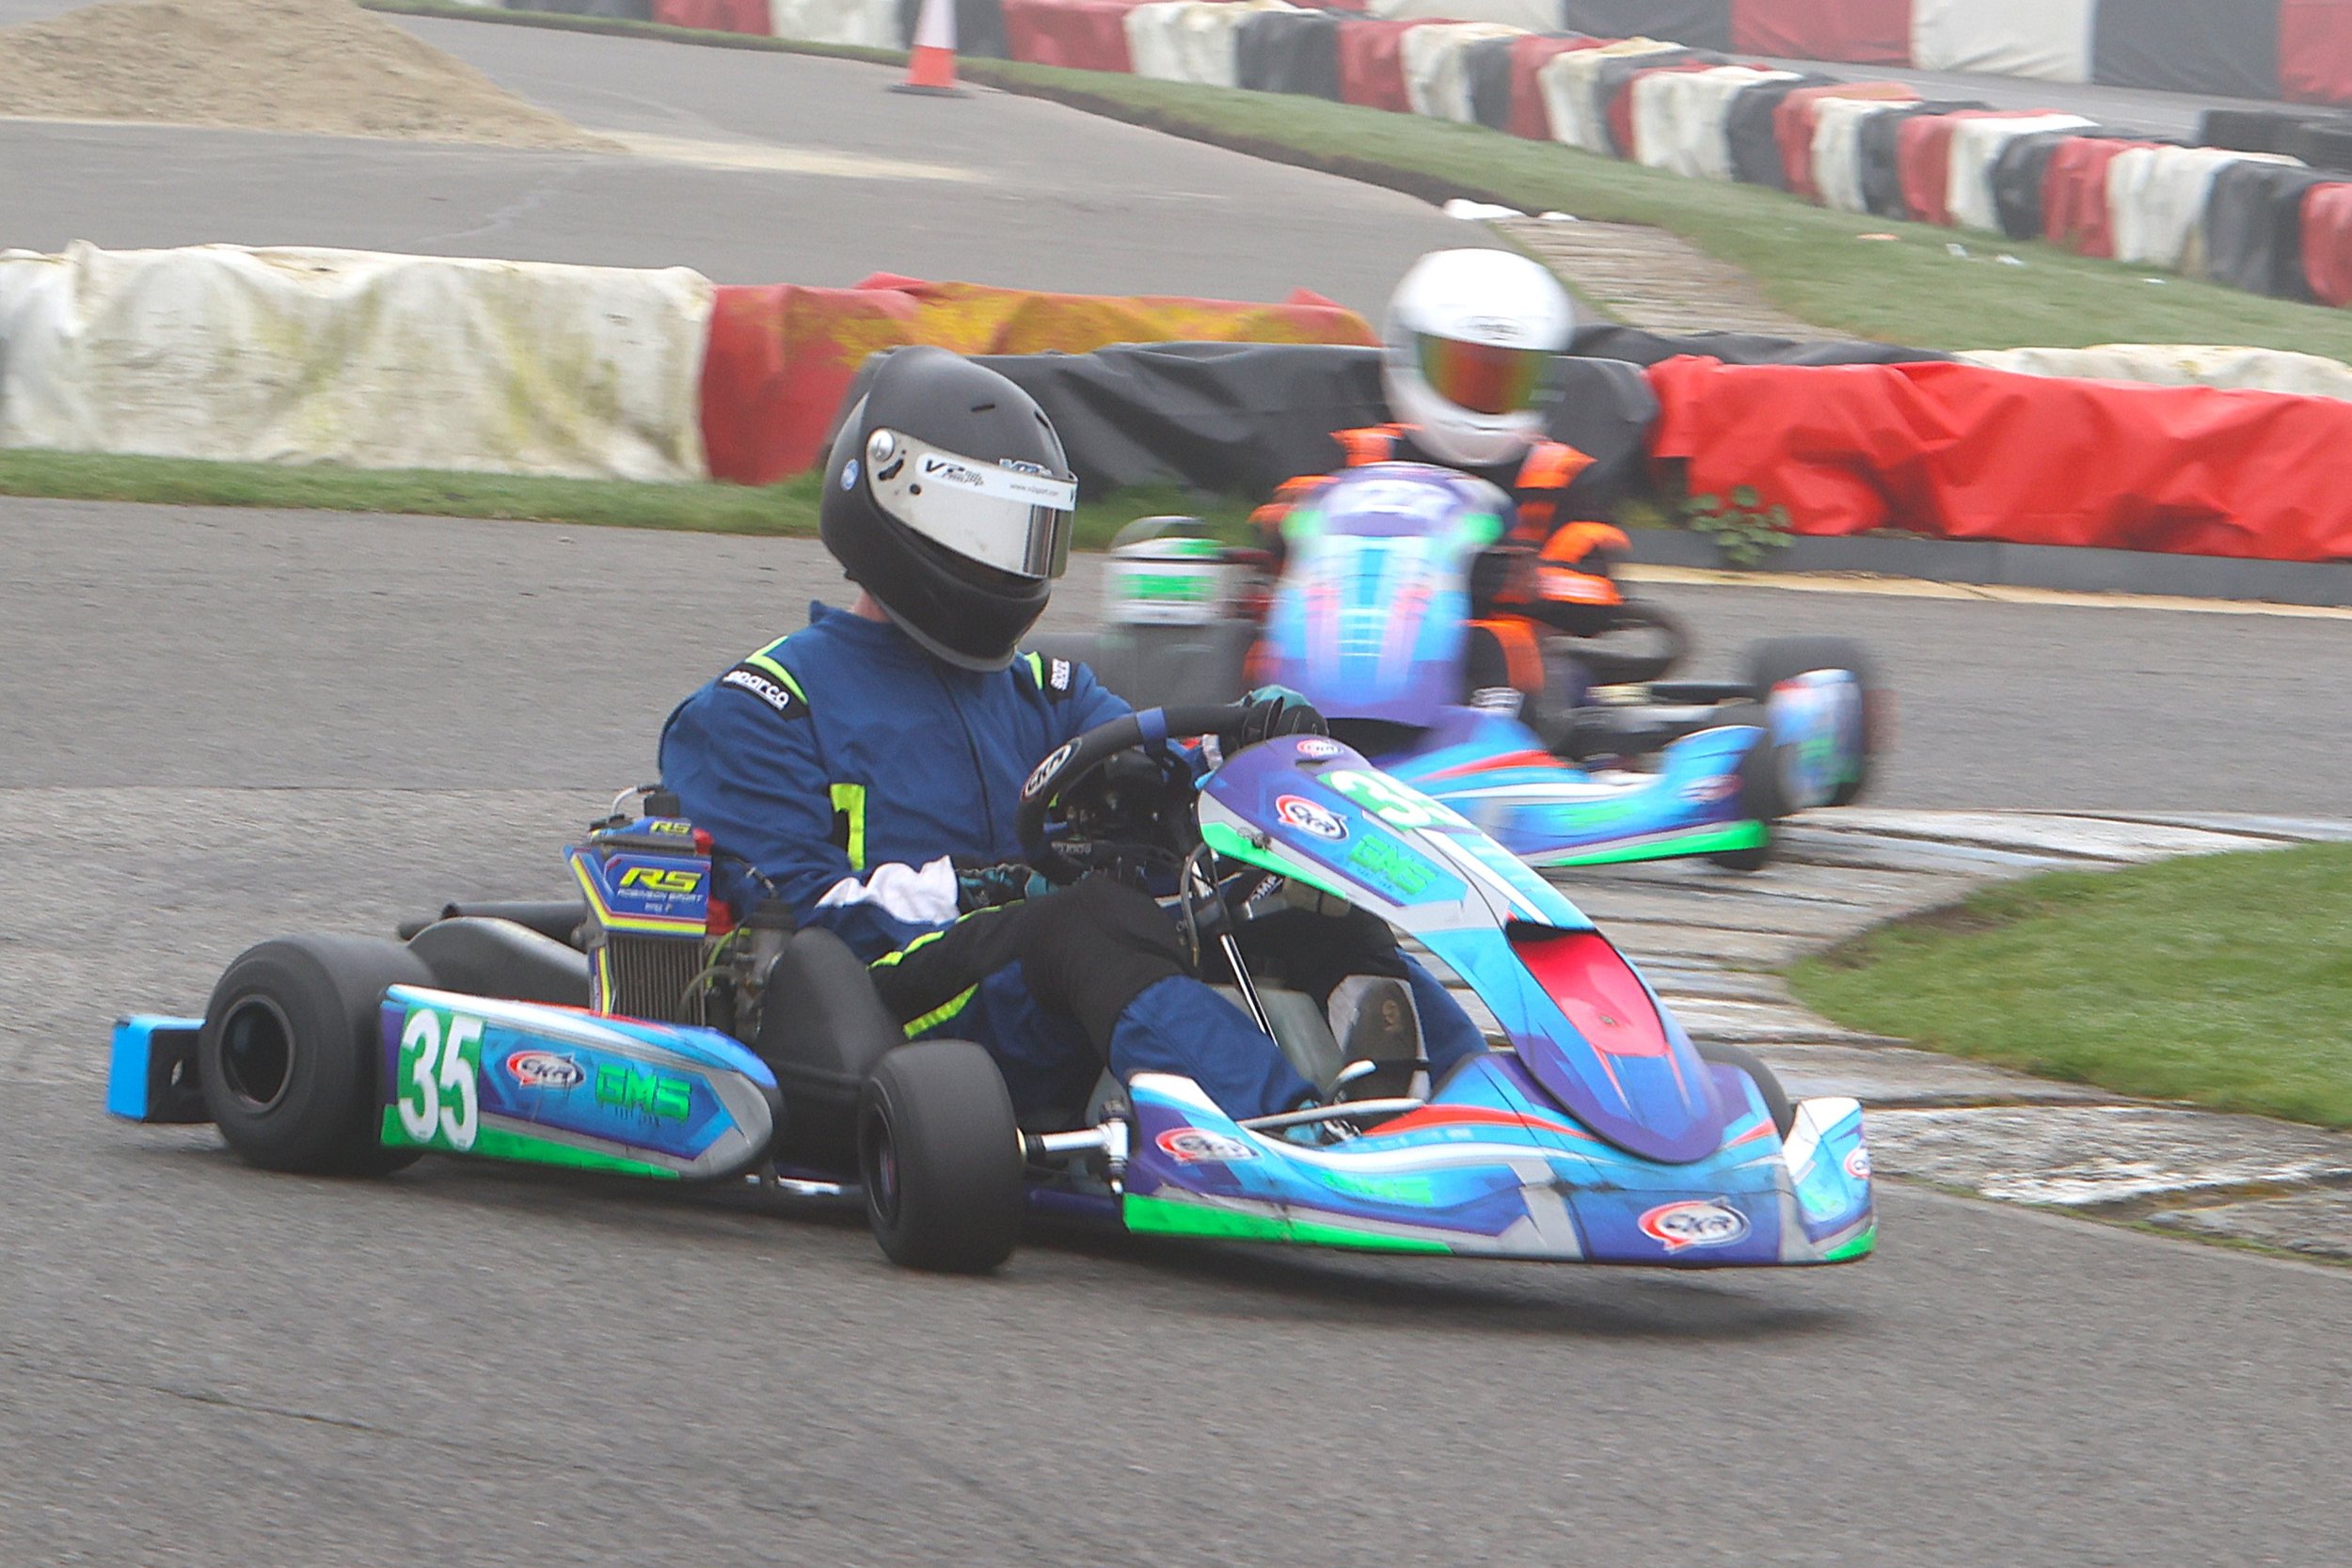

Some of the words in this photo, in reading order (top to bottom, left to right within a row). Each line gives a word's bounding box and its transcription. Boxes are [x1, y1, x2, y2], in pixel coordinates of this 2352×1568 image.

[649, 820, 691, 834] RS
[619, 866, 703, 893] RS
[397, 1008, 485, 1151] 35
[596, 1062, 692, 1123] GMS
